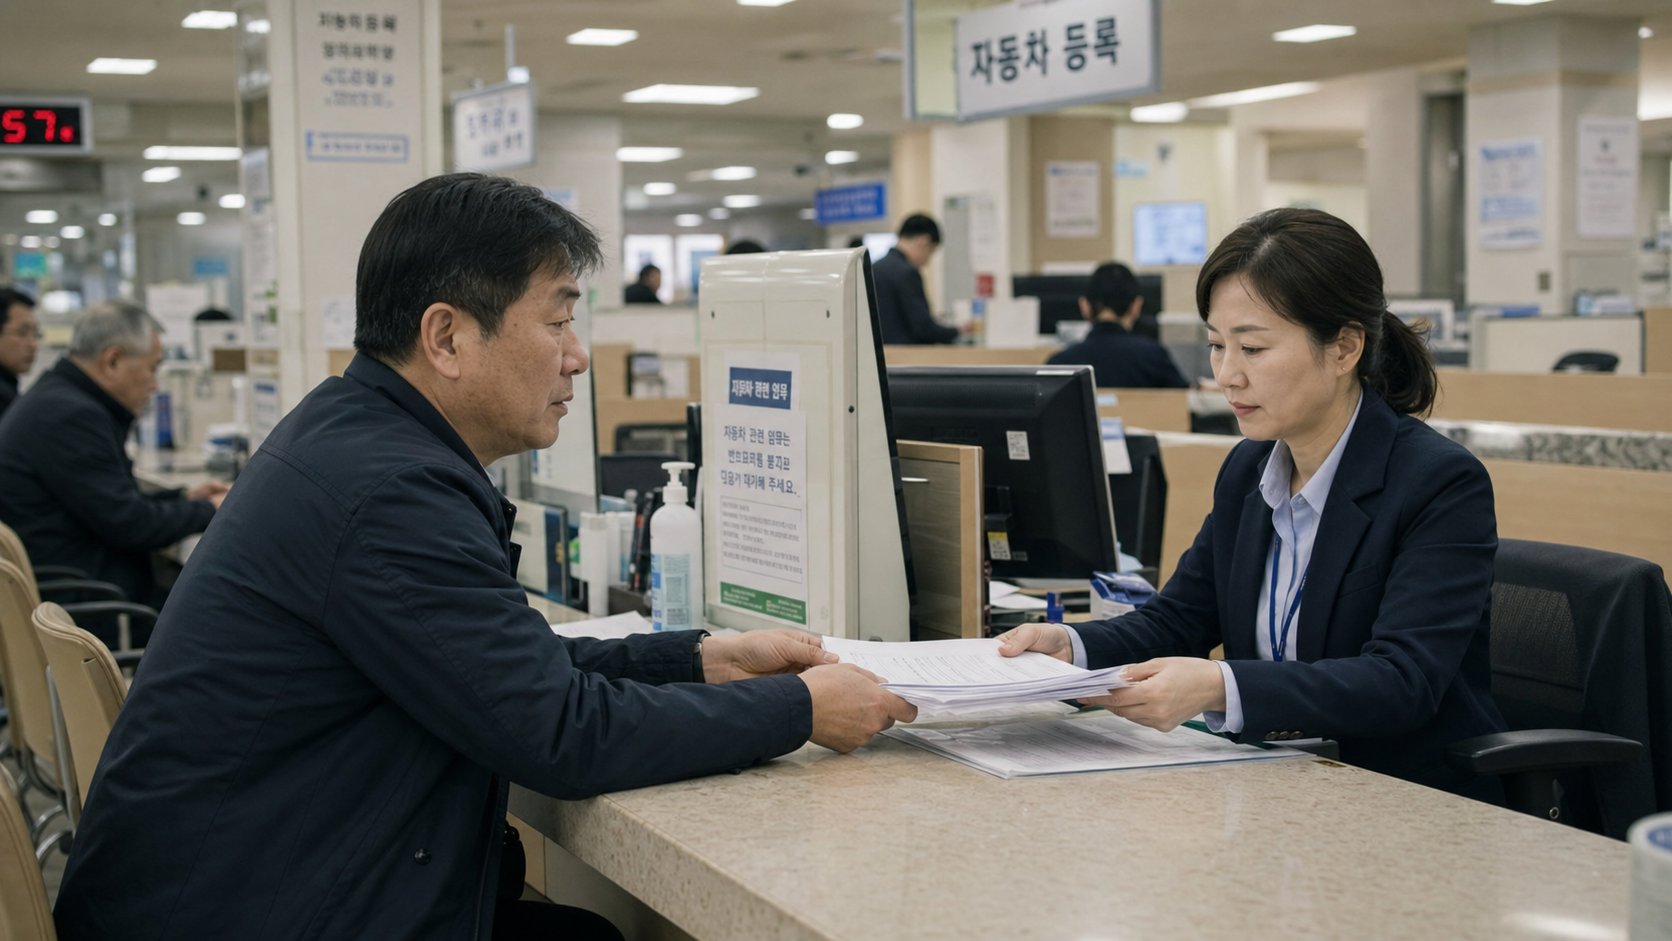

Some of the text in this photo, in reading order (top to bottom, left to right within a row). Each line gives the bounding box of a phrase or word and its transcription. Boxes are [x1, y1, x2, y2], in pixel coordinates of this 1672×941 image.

[970, 17, 1121, 85] 자동차 등록
[723, 425, 746, 442] 자동차
[750, 427, 764, 444] 관련
